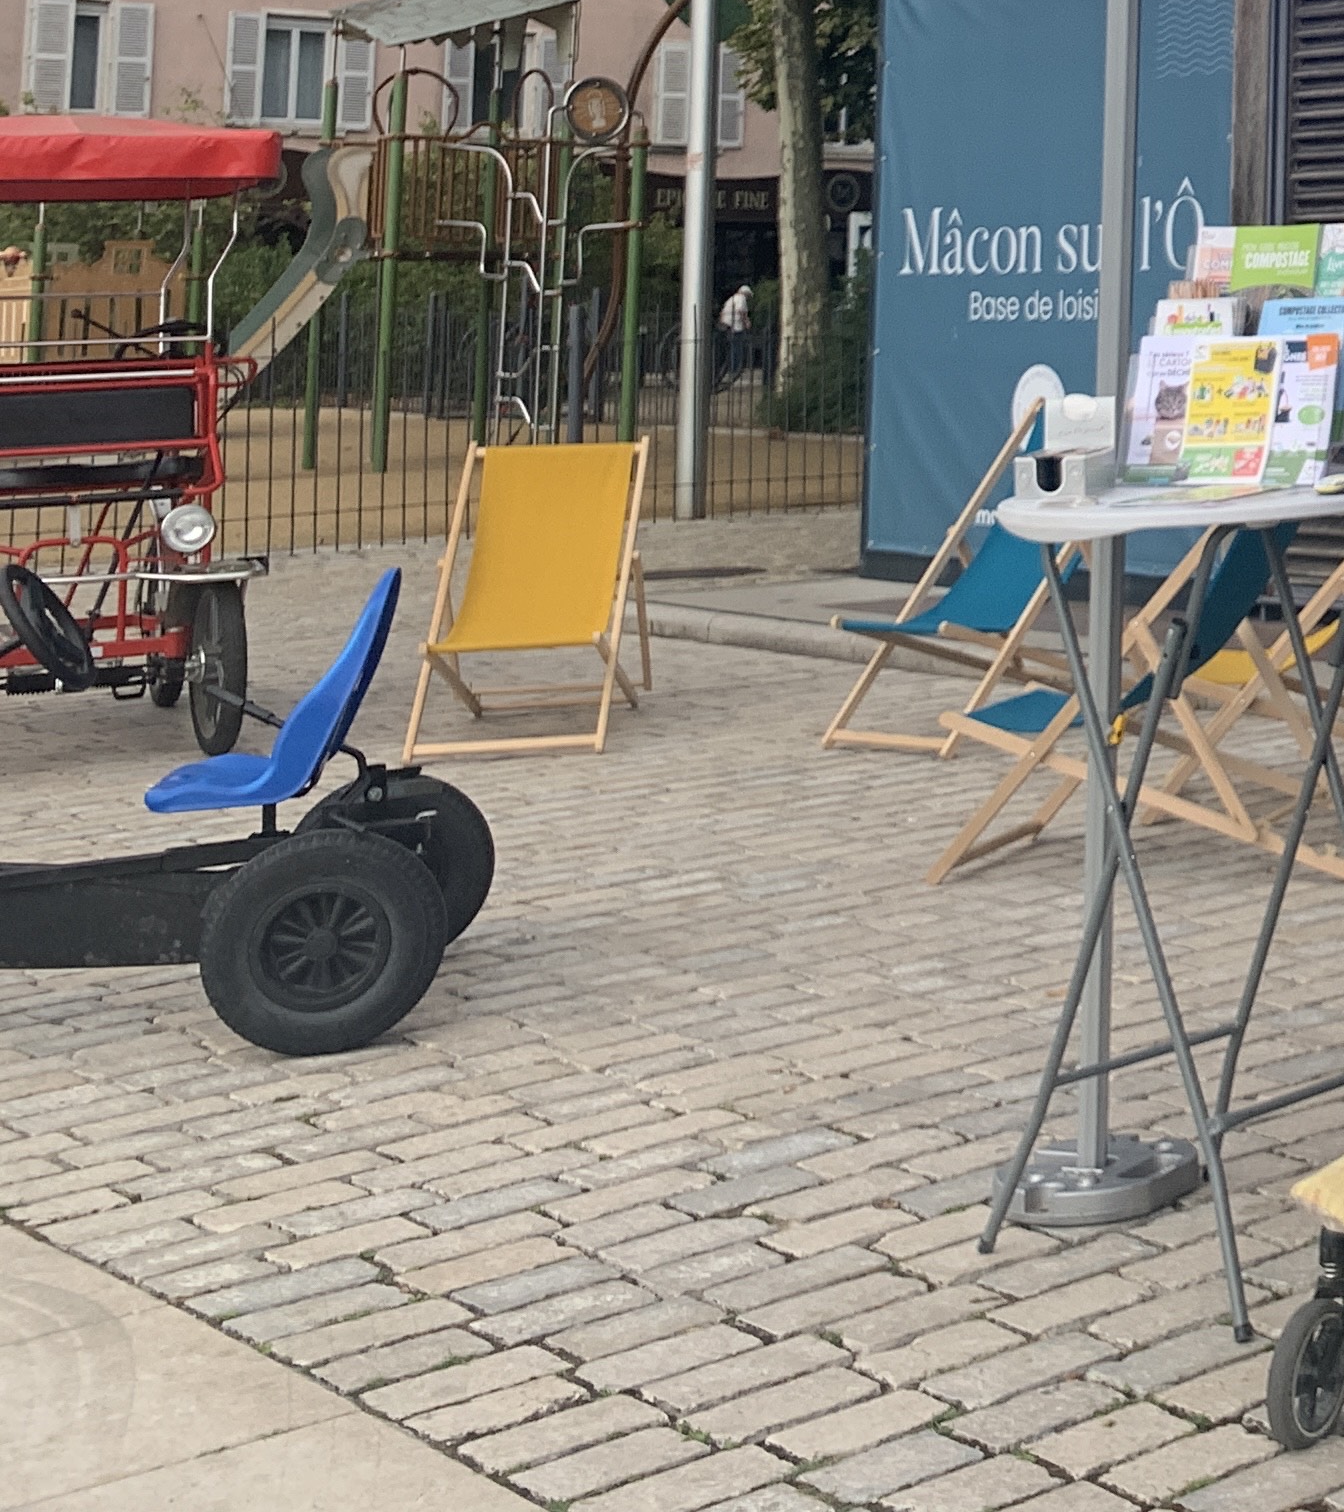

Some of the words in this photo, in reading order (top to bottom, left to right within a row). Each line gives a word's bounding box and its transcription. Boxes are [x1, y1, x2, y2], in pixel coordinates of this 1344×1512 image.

[898, 206, 1043, 277] Mâcon
[1056, 222, 1104, 274] su
[968, 290, 1020, 322] Base
[1024, 289, 1052, 321] de
[1058, 287, 1100, 321] loisi
